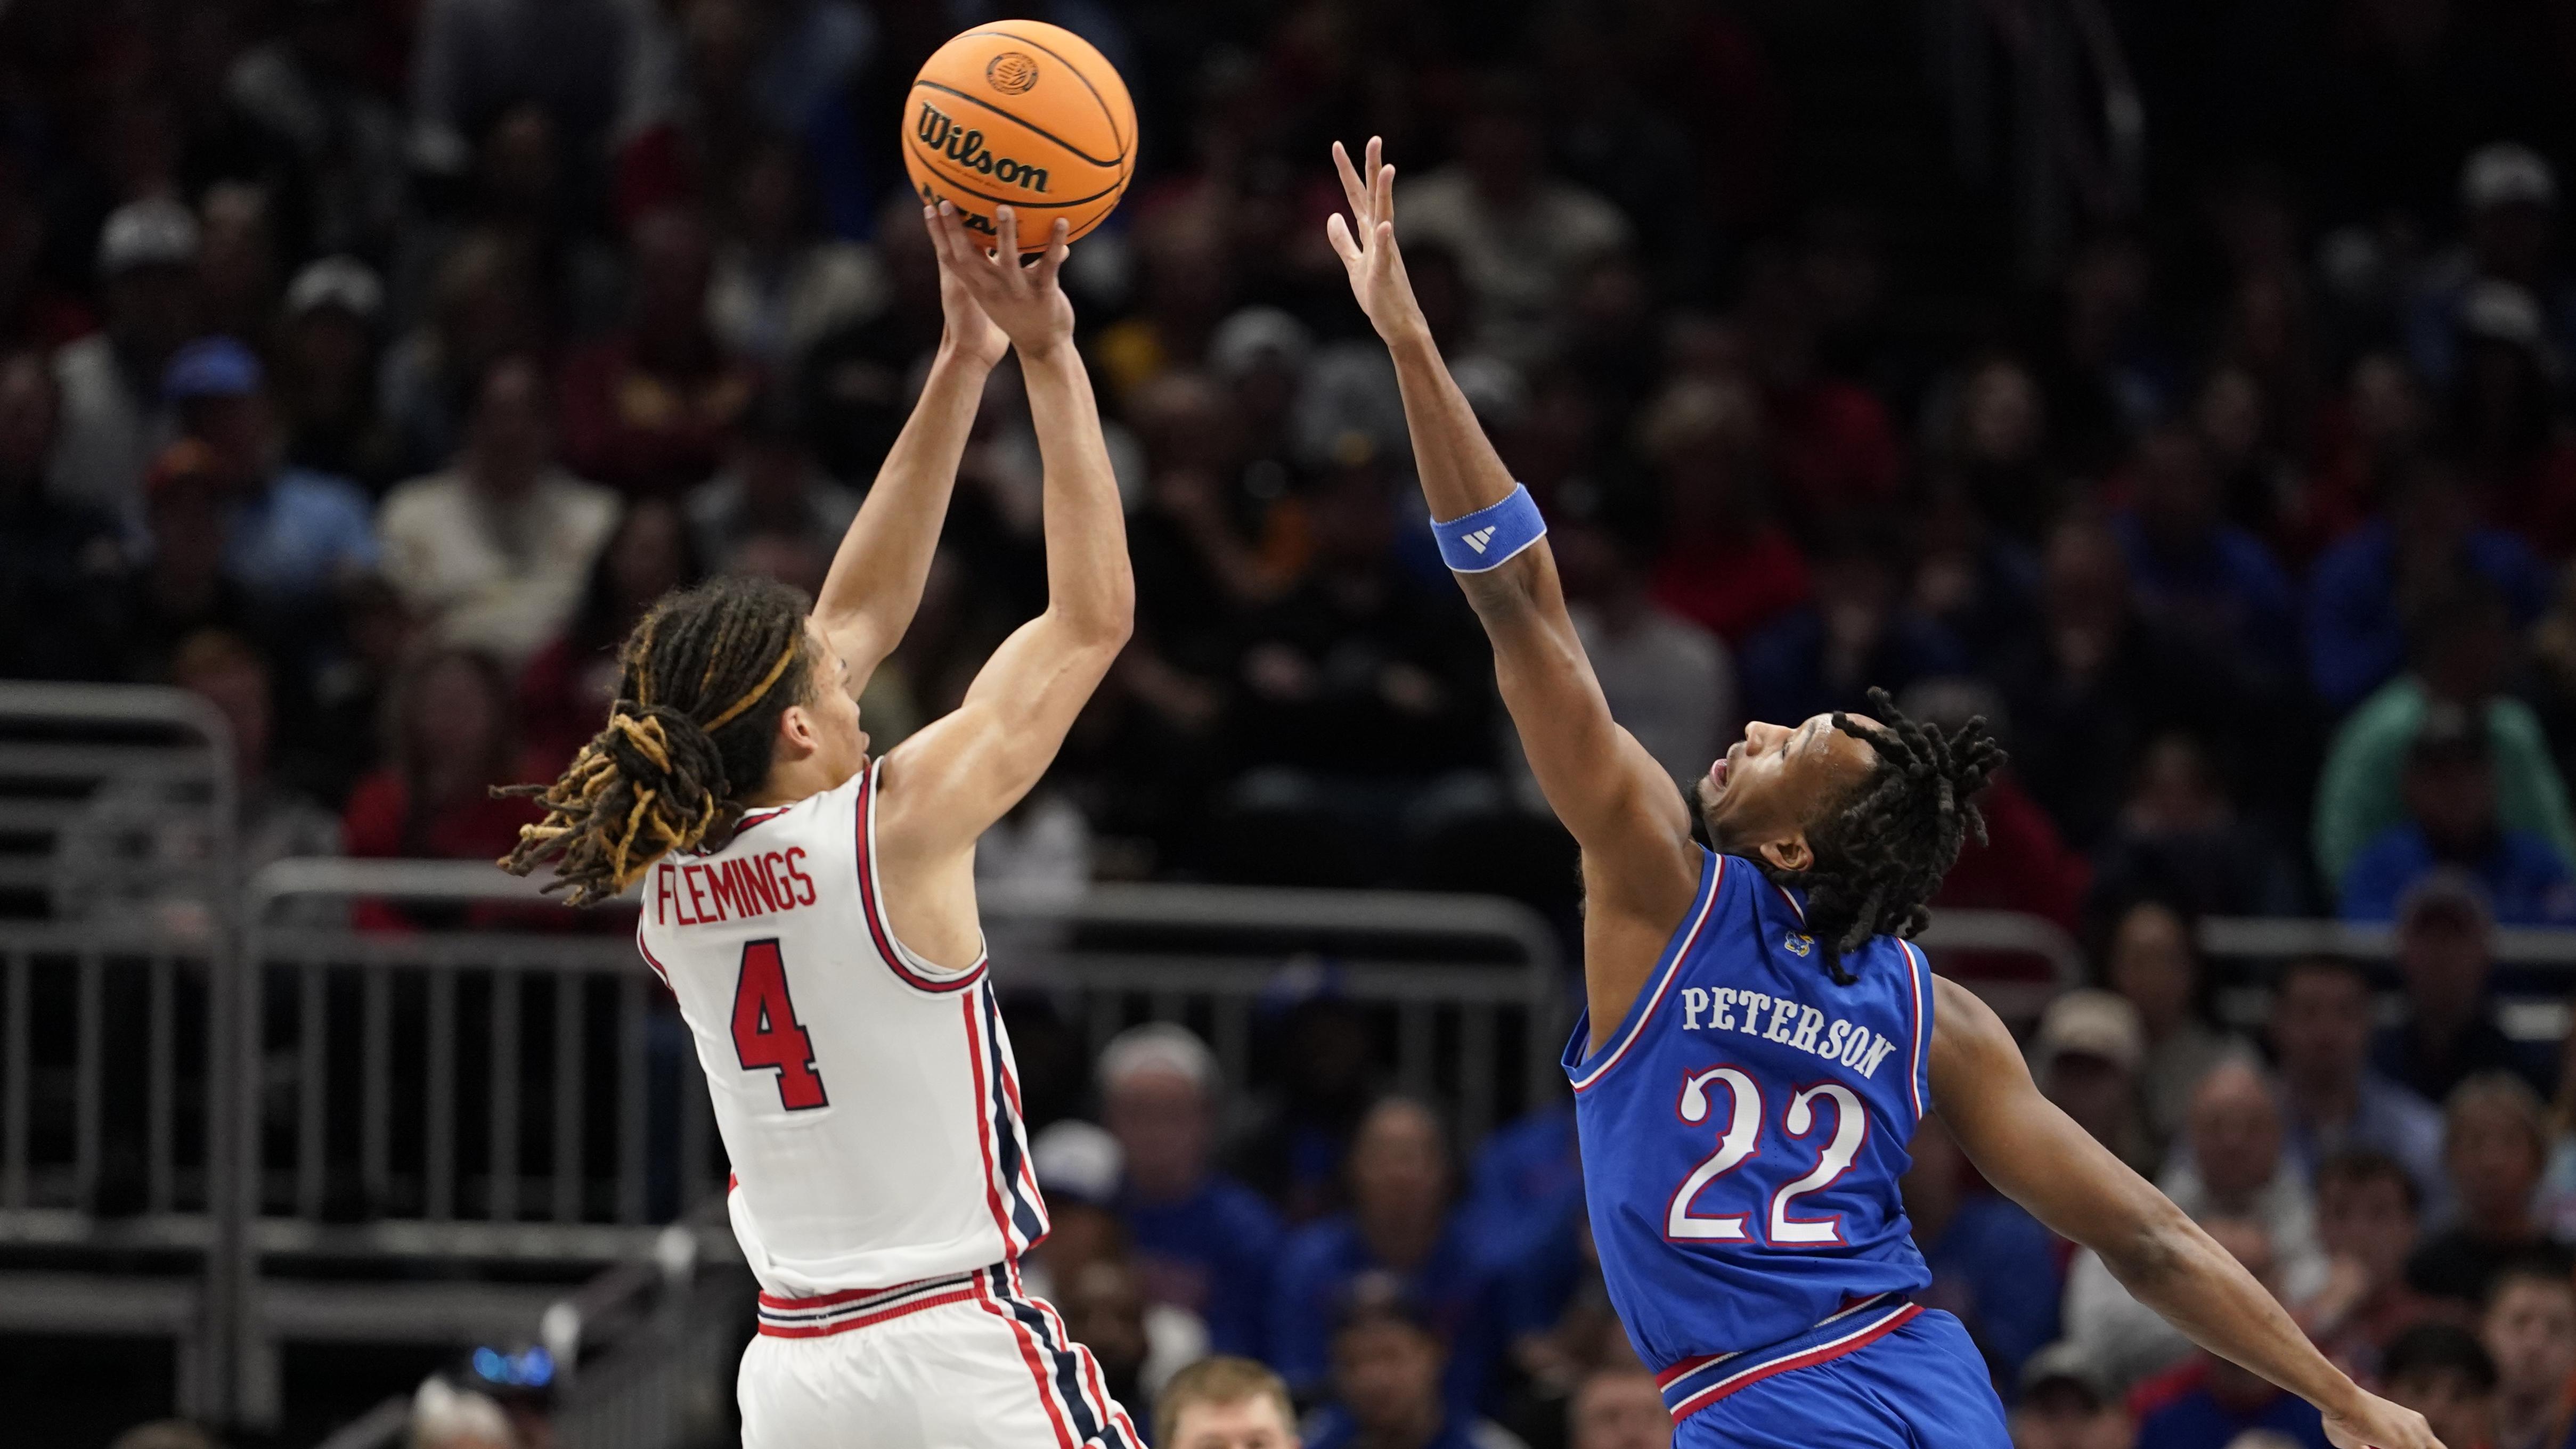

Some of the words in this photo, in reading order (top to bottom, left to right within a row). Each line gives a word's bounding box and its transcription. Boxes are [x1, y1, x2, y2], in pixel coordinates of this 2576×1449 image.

[918, 101, 1049, 192] Wilson
[657, 847, 816, 926] FLEMINGS
[731, 938, 829, 1111] 4
[1682, 987, 1896, 1079] PETERSON
[1664, 1063, 1870, 1246] 22
